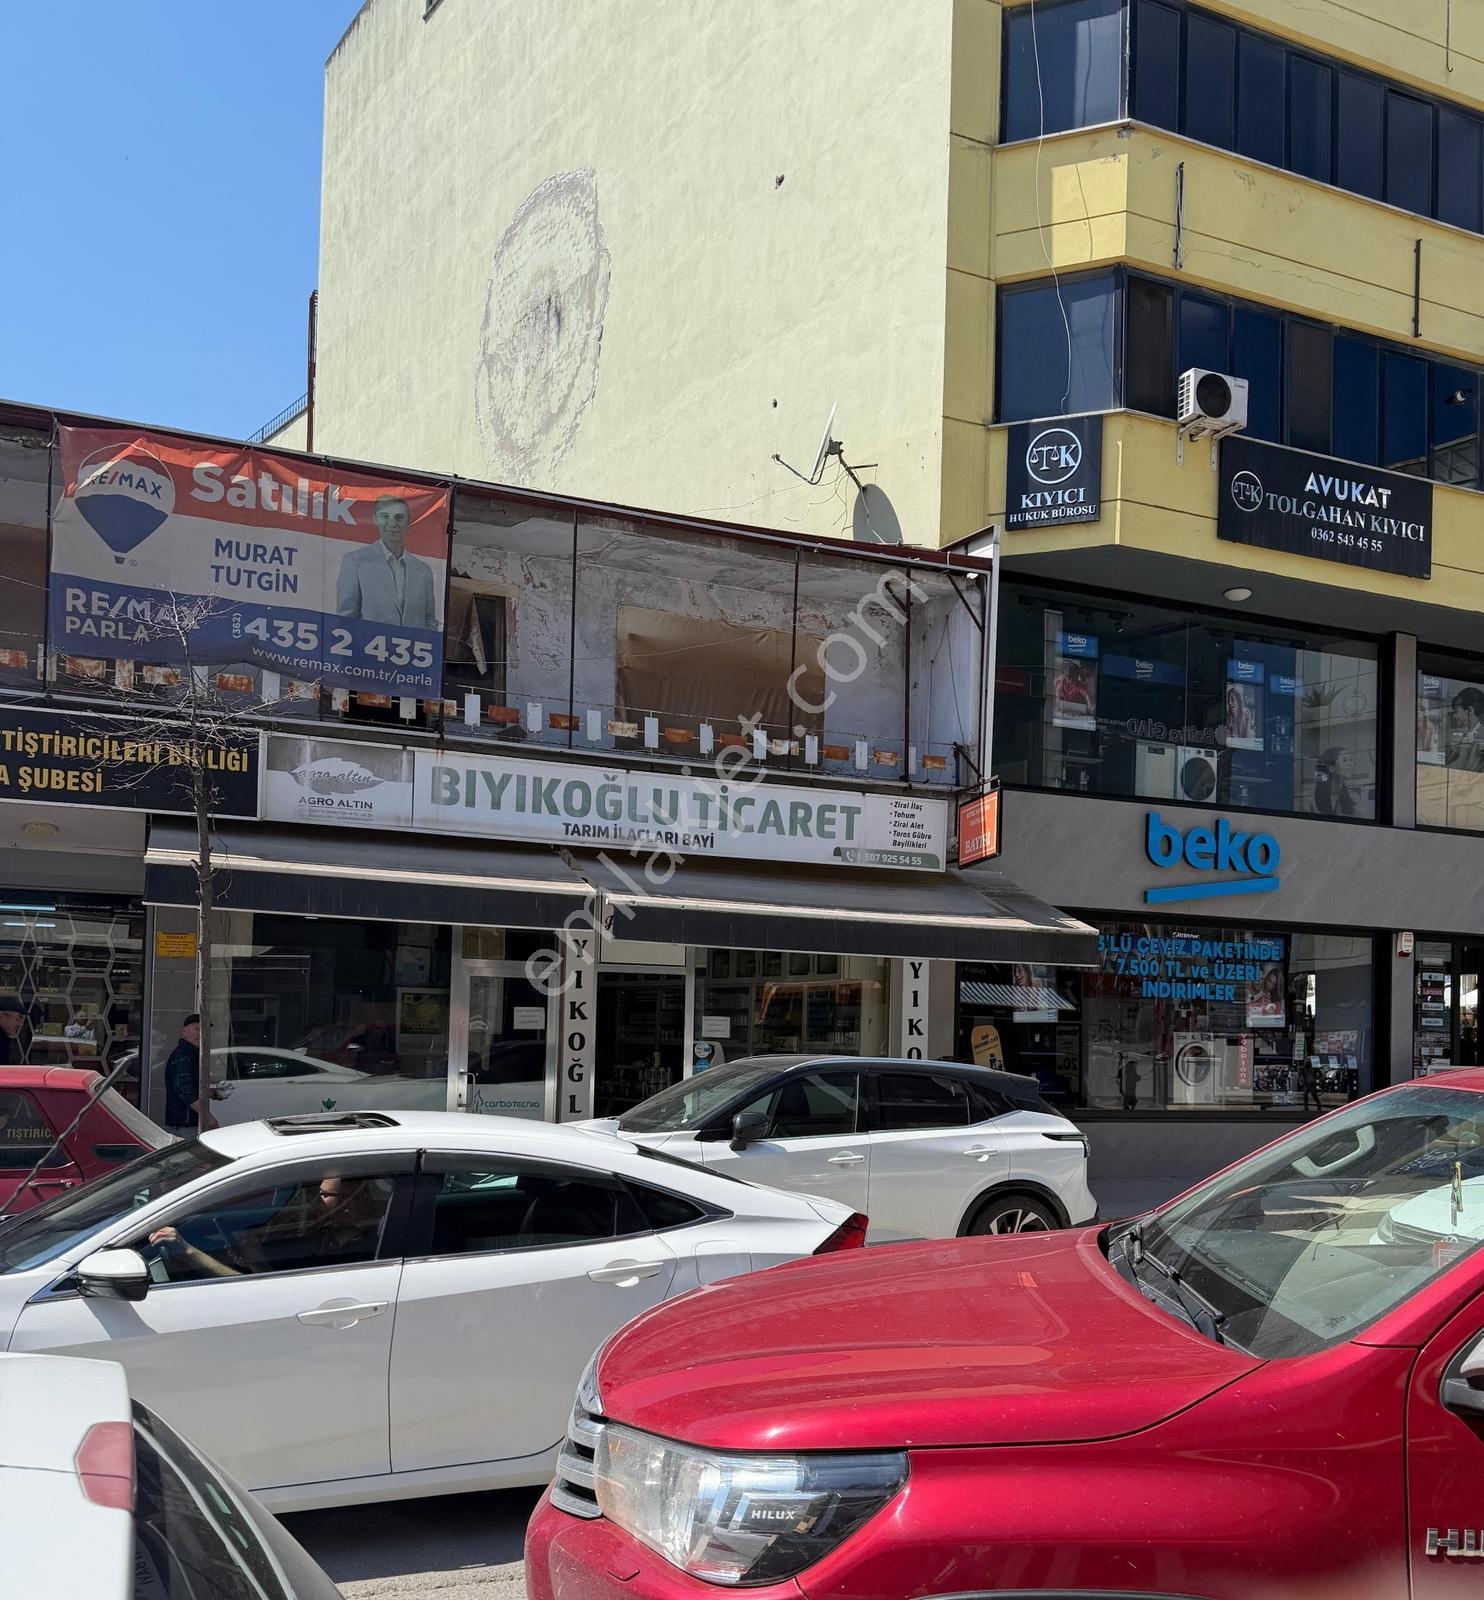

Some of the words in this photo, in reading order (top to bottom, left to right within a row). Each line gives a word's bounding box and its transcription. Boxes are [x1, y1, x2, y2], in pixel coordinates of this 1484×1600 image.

[190, 461, 357, 525] Satılık
[1021, 487, 1086, 509] KIYICI
[1304, 471, 1392, 510] AVUKAT
[1009, 510, 1049, 523] HUKUK
[1051, 504, 1097, 519] BÜROSU
[1266, 491, 1366, 529] TOLGAHAN
[1370, 514, 1425, 542] KIYICI
[214, 538, 298, 567] MURAT
[1310, 527, 1334, 543] 0362
[1337, 532, 1354, 547] 543
[1357, 536, 1368, 550] 45
[1371, 540, 1383, 552] 55
[210, 564, 299, 594] TUTGİN
[65, 615, 151, 643] PARLA
[232, 612, 243, 639] (362)
[244, 617, 319, 650] 435
[329, 628, 353, 657] 2
[363, 635, 434, 668] 435
[1067, 634, 1087, 645] beko
[251, 645, 434, 687] www.remax.com.tr/parla
[1135, 659, 1153, 670] beko
[18, 766, 103, 793] ŞUBESİ
[299, 796, 334, 807] AGRO
[337, 799, 373, 810] ALTIN
[430, 766, 679, 826] BIYIKOĞLU
[692, 784, 862, 841] TİCARET
[562, 822, 610, 839] TARIM
[682, 831, 714, 849] BAYİ
[910, 821, 924, 830] Alet
[1145, 811, 1281, 875] beko
[882, 854, 898, 863] 925
[899, 855, 910, 864] 54
[911, 856, 922, 865] 55
[1191, 939, 1281, 962] PAKETİNDE
[1116, 958, 1160, 977] 7.500
[1164, 959, 1185, 978] TL
[1190, 965, 1209, 979] ve
[1214, 960, 1261, 982] ÜZERİ
[1142, 975, 1236, 1001] İNDİRİMLER
[751, 1509, 796, 1520] HILUX
[1425, 1527, 1484, 1557] HI
